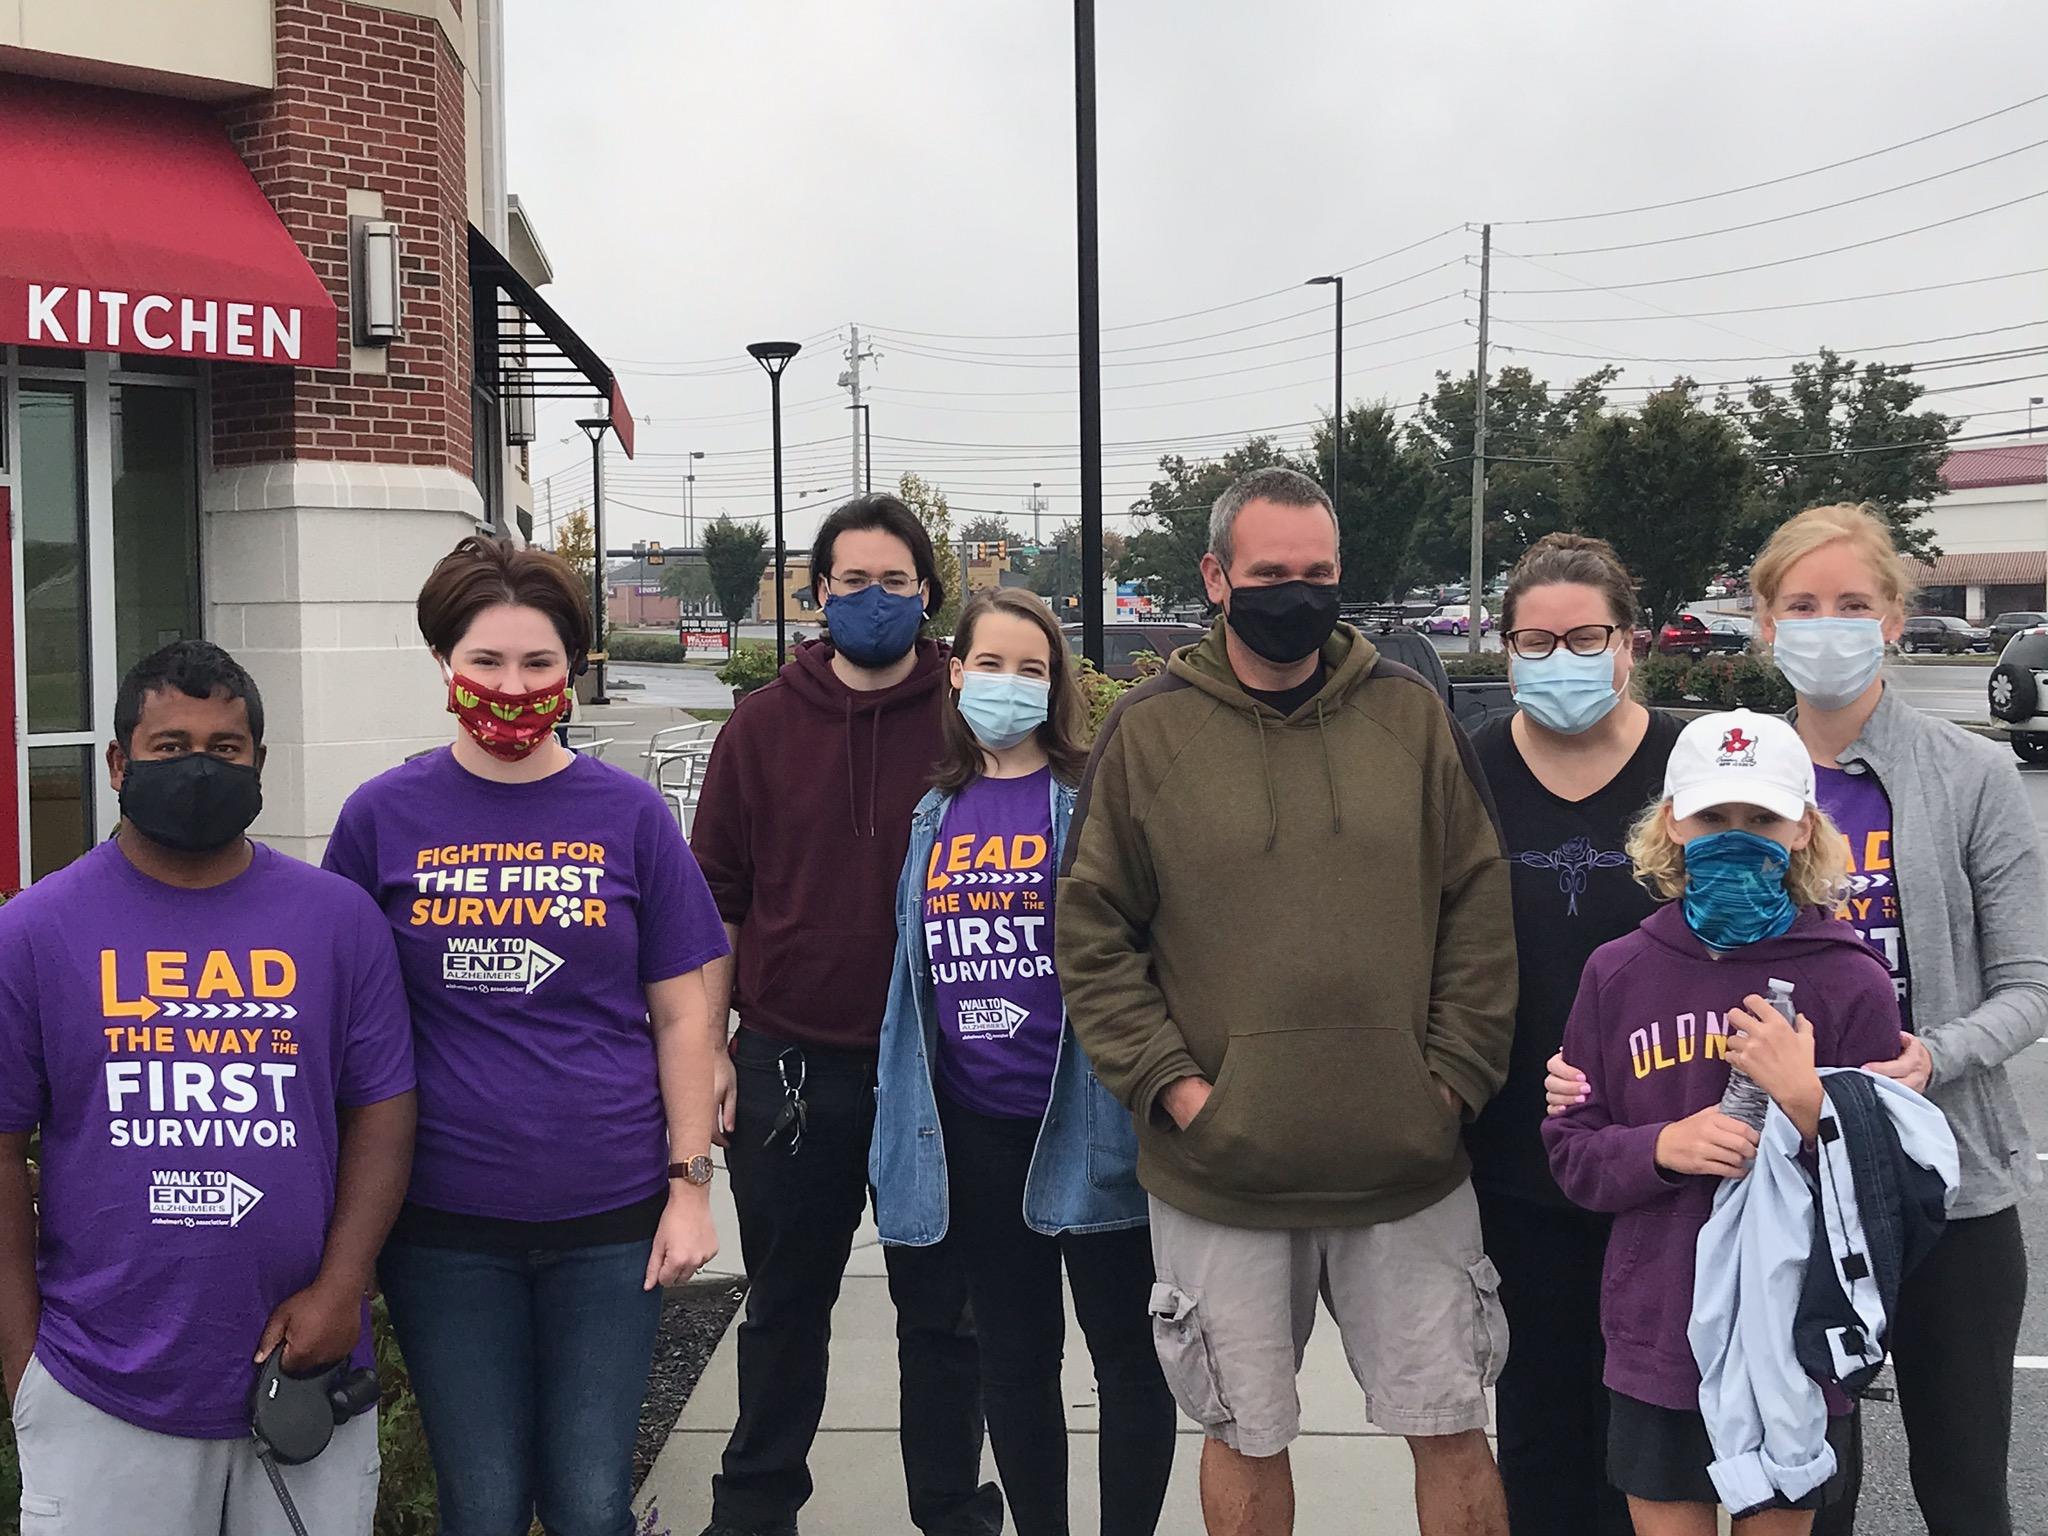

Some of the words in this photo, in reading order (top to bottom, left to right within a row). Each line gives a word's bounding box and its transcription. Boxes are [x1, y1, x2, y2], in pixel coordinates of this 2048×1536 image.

[28, 284, 301, 360] KITCHEN
[416, 842, 544, 869] FIGHTING
[552, 841, 606, 865] FOR
[927, 834, 1047, 891] LEAD
[412, 867, 490, 893] THE
[500, 865, 605, 894] FIRST
[1022, 891, 1038, 900] TO
[1022, 901, 1045, 910] THE
[447, 938, 499, 953] WALK
[501, 938, 525, 953] TO
[924, 915, 1045, 960] FIRST
[446, 955, 523, 971] END
[930, 955, 1054, 985] SURVIVOR
[101, 949, 297, 1022] LEAD
[446, 971, 521, 980] ALZHEIMER'S
[987, 997, 1001, 1009] TO
[961, 1011, 1003, 1024] END
[104, 1027, 175, 1053] THE
[185, 1028, 263, 1054] WAY
[272, 1029, 292, 1041] TO
[271, 1042, 299, 1055] THE
[1628, 1012, 1696, 1079] OLD
[105, 1060, 297, 1113] FIRST
[109, 1119, 297, 1147] SURVIVOR
[151, 1170, 201, 1186] WALK
[203, 1171, 226, 1186] TO
[153, 1188, 226, 1204] END
[153, 1204, 226, 1212] ALZHEIMER'S
